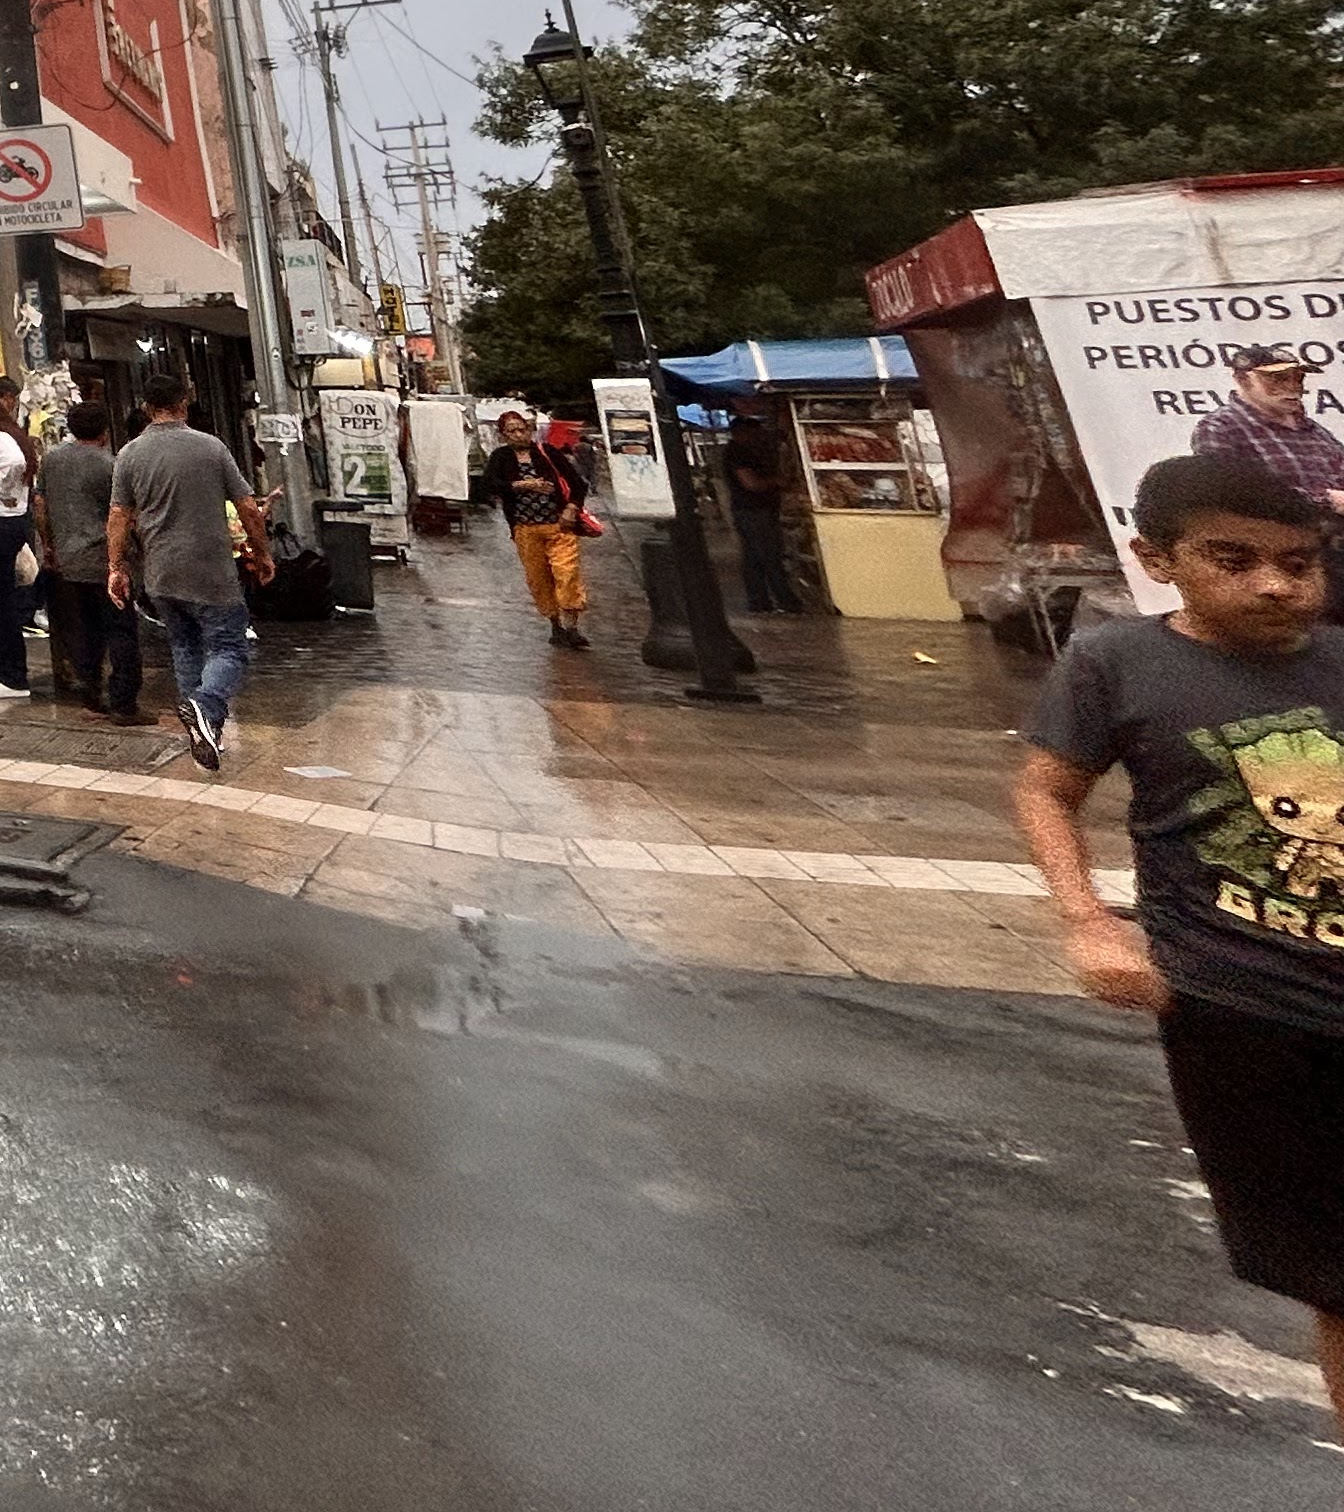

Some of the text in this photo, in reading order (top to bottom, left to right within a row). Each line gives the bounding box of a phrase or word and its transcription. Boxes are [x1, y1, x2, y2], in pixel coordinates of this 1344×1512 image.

[28, 200, 73, 213] CIRCULAR
[4, 212, 63, 226] MOTOCICLETA
[1085, 293, 1344, 325] PUESTOS D
[340, 417, 383, 430] PEPE
